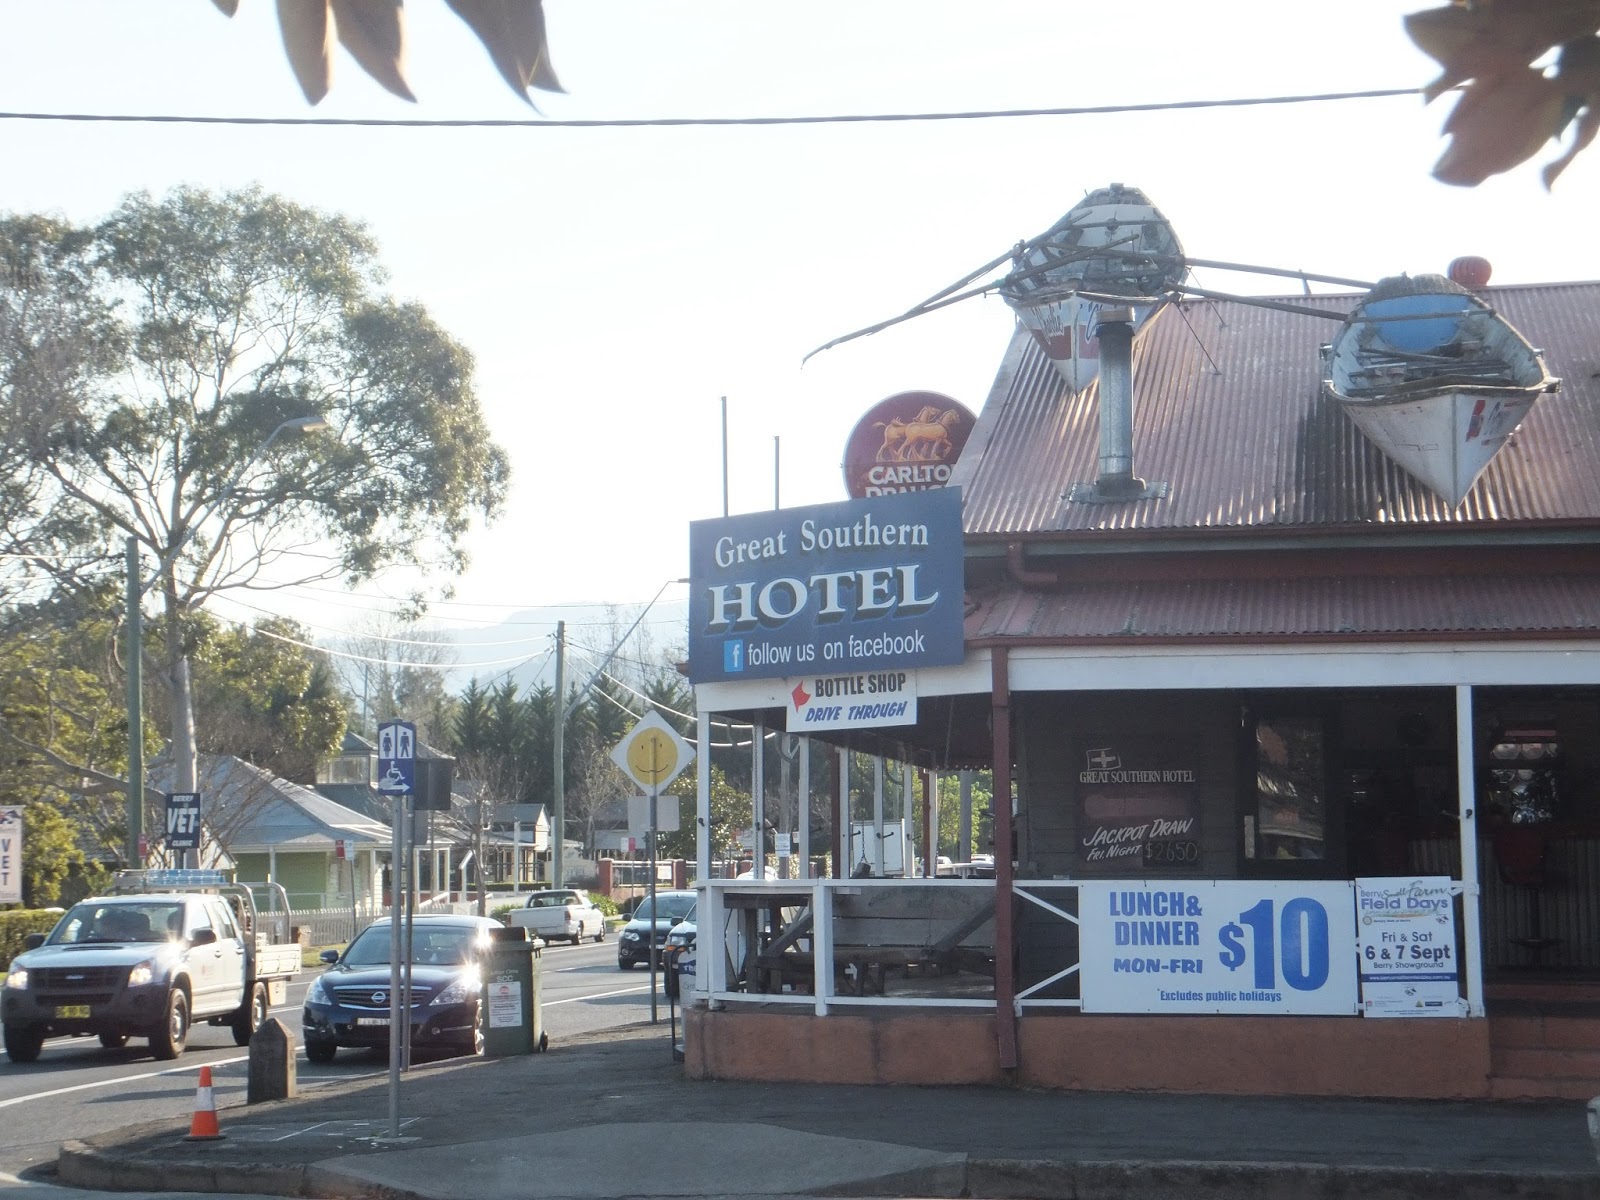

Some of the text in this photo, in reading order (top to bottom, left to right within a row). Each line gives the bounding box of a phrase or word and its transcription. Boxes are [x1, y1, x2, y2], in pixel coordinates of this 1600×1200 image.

[869, 464, 956, 485] CARLTO
[714, 513, 929, 568] Great Southern
[707, 564, 939, 626] HOTEL
[748, 642, 791, 666] follow
[796, 643, 815, 662] us
[823, 642, 844, 660] on
[848, 629, 925, 658] facebook
[815, 672, 906, 698] BOTTLE SHOP
[805, 701, 908, 722] DRIVE THROUGH
[1080, 770, 1196, 783] GREAT SOUTHERN HOTEL
[167, 807, 199, 834] VET
[1083, 818, 1194, 847] JACKPOT DRAW
[1105, 844, 1142, 858] NIGHT
[1361, 889, 1381, 899] Berry
[1406, 880, 1448, 899] Farm
[1361, 898, 1400, 910] Field
[1407, 897, 1448, 912] Days
[1115, 921, 1200, 946] DINNER
[1382, 931, 1433, 943] Fri & Sat
[1218, 897, 1330, 992] $10
[1365, 944, 1451, 962] 6 & 7 Sept
[1113, 957, 1203, 974] MON-FRI
[1395, 961, 1444, 970] Showground
[1206, 990, 1237, 1003] public
[1239, 990, 1282, 1003] holidays
